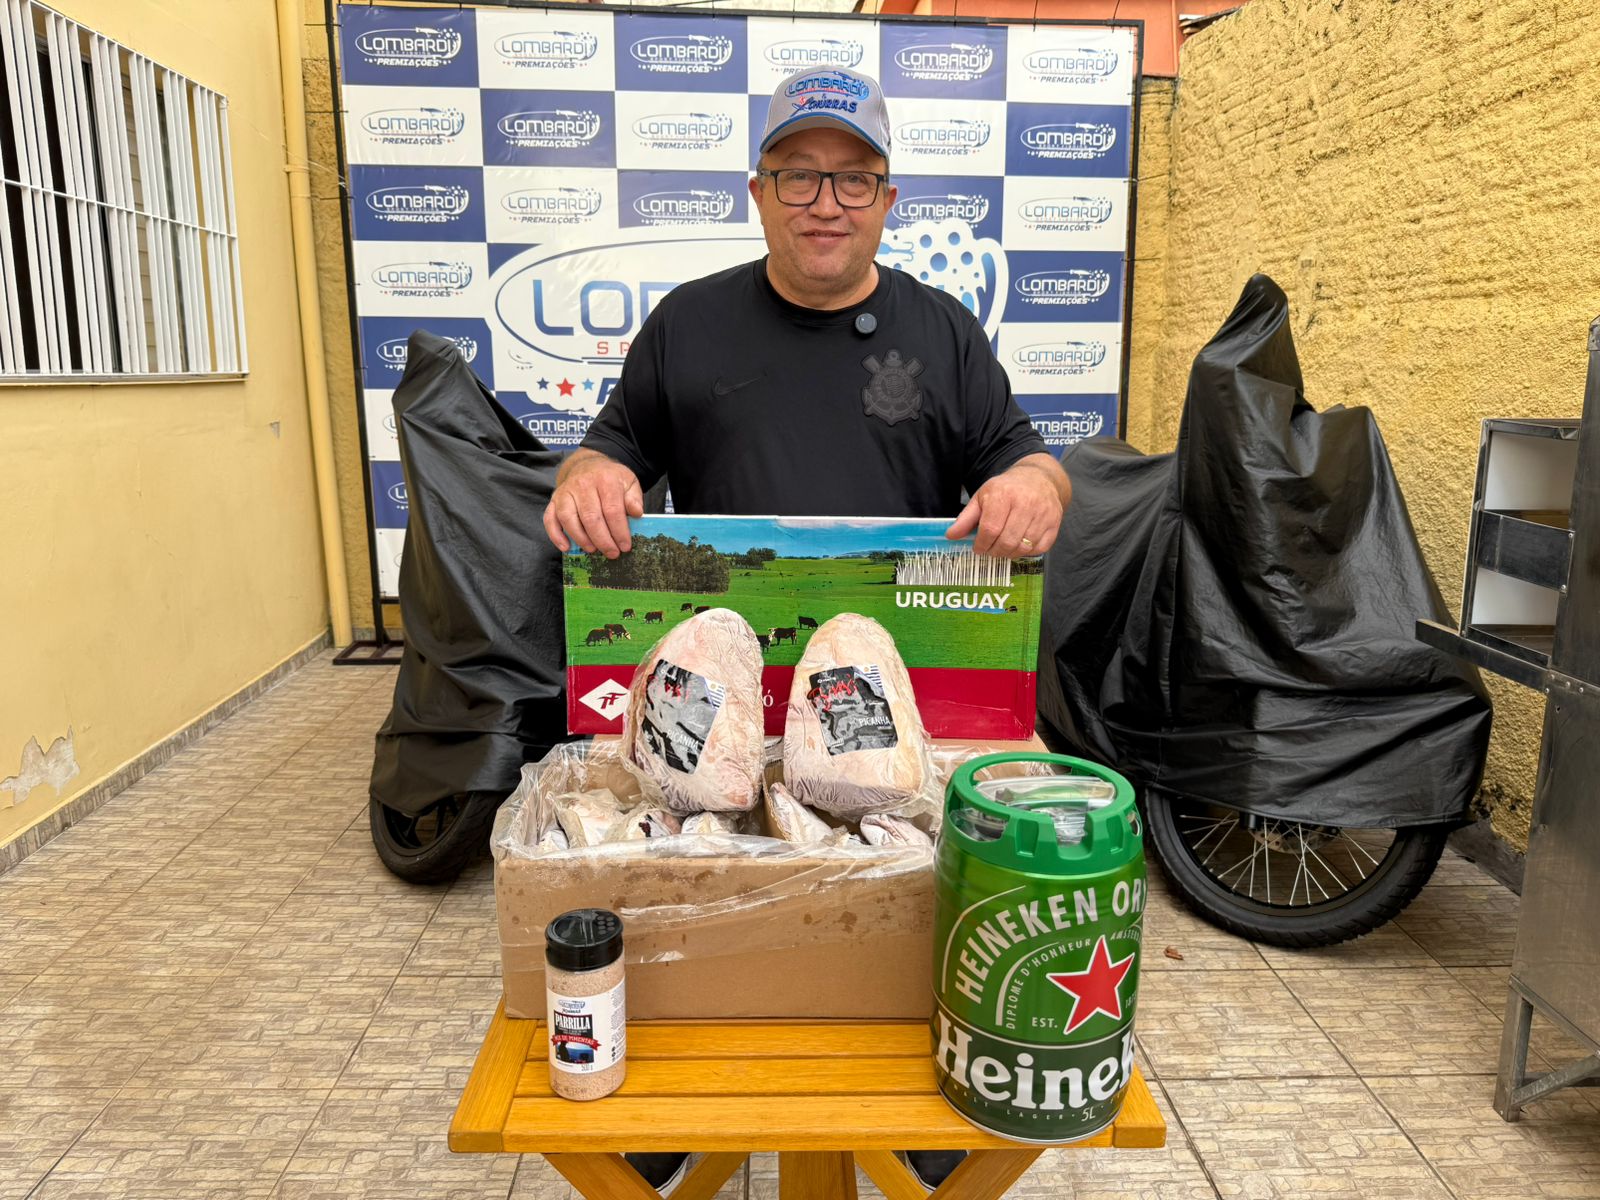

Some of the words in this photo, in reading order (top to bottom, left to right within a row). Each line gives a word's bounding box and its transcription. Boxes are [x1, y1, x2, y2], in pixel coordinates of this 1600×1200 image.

[362, 37, 451, 53] LOMBARDI
[501, 39, 588, 56] LOMBARDI
[637, 44, 724, 60] LOMBARDI
[771, 48, 853, 63] LOMBARDI
[901, 52, 983, 68] LOMBARDI
[1029, 55, 1109, 71] LOMBARDI
[789, 77, 862, 96] LOMBARDI
[368, 117, 455, 132] LOMBARDI
[504, 119, 589, 136] LOMBARDI
[639, 121, 723, 137] LOMBARDI
[900, 127, 982, 144] LOMBARDI
[1027, 131, 1107, 147] LOMBARDI
[373, 194, 460, 211] LOMBARDI
[508, 196, 592, 212] LOMBARDI
[640, 199, 724, 214] LOMBARDI
[899, 203, 979, 219] LOMBARDI
[1025, 206, 1104, 222] LOMBARDI
[378, 271, 463, 286] LOMBARDI
[1022, 278, 1102, 293] LOMBARDI
[1019, 350, 1099, 366] LOMBARDI
[896, 591, 1010, 609] URUGUAY
[860, 716, 891, 727] PICANHA
[667, 729, 699, 749] PICANHA
[955, 887, 1099, 1004] HEINEKEN
[1006, 979, 1024, 1029] DIPLOME
[1020, 938, 1091, 976] D'HONNEUR
[555, 1014, 590, 1030] PARRILLA
[1031, 1017, 1058, 1028] EST.
[1006, 1109, 1064, 1120] LAGER
[1081, 1107, 1096, 1122] 5L
